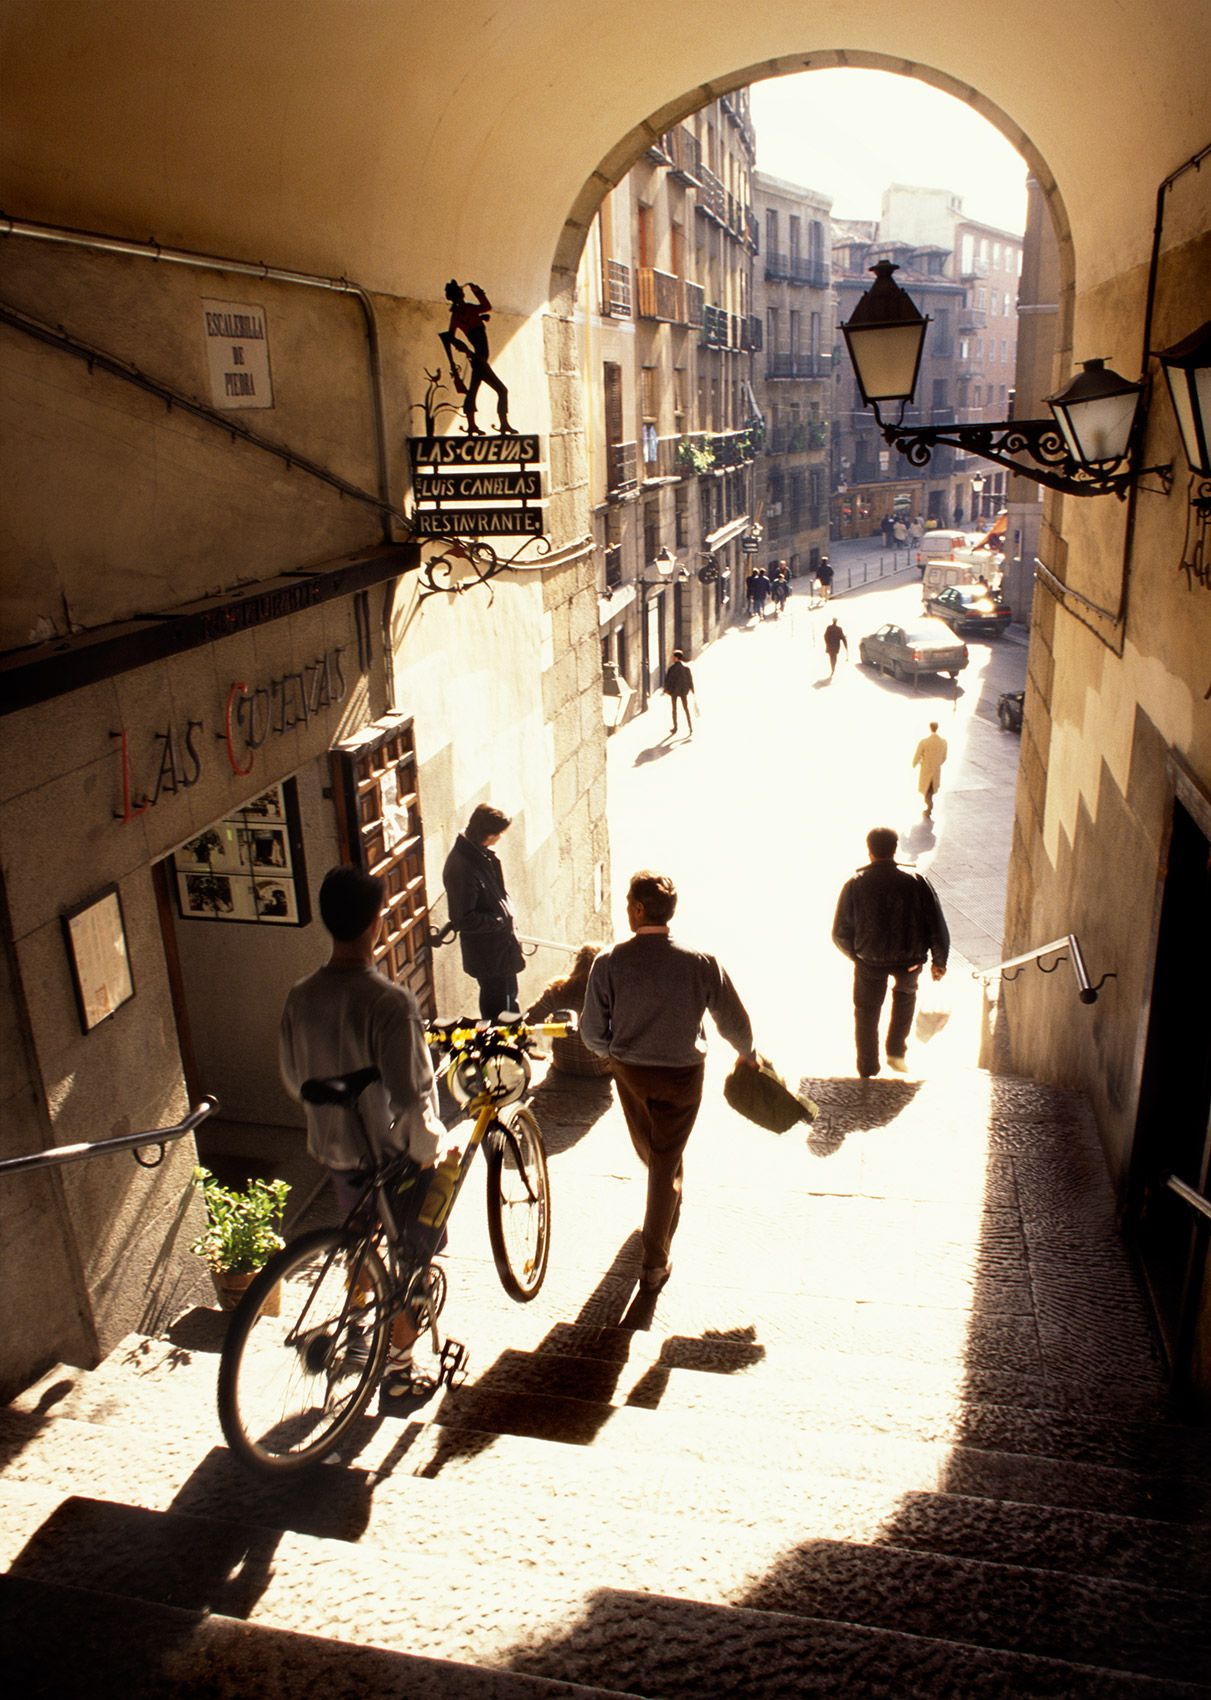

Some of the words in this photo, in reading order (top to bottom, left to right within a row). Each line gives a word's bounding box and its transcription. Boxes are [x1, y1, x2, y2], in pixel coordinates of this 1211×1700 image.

[416, 440, 456, 463] LAS
[461, 439, 534, 461] CUEVAS
[112, 718, 203, 824] LAS
